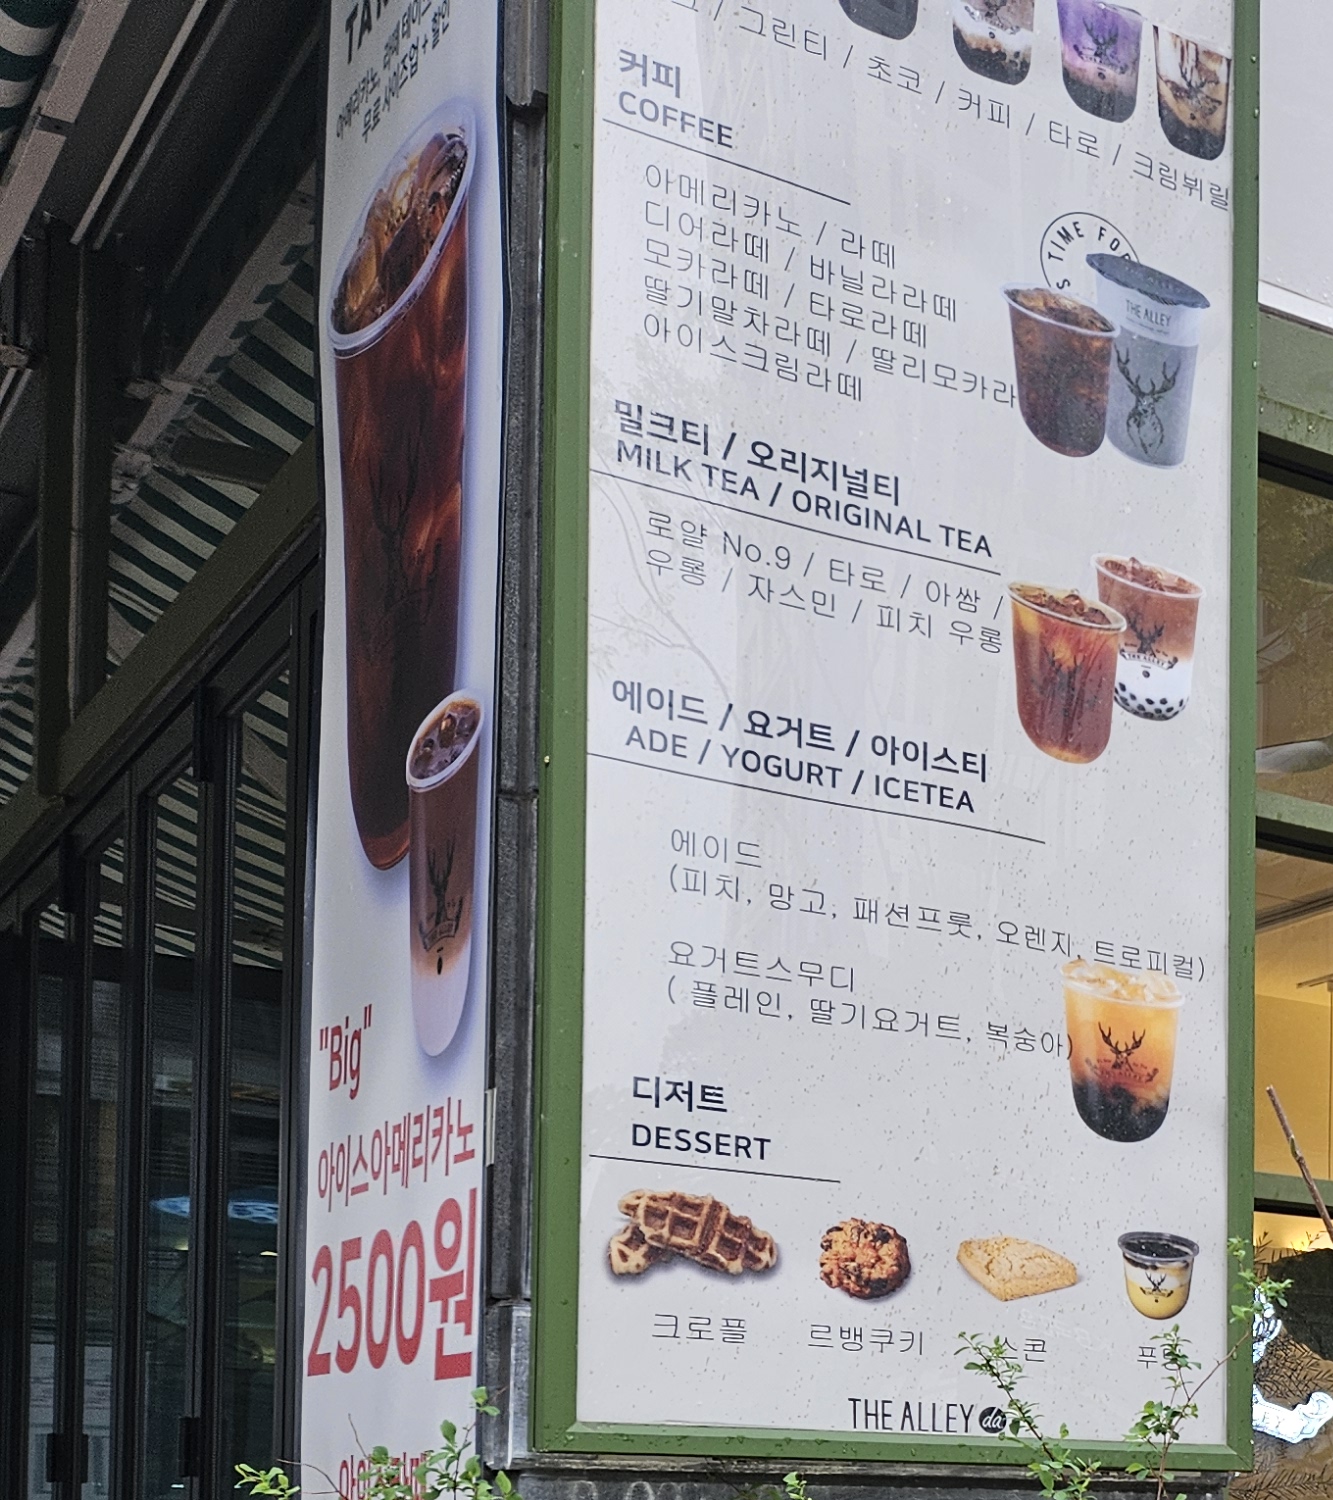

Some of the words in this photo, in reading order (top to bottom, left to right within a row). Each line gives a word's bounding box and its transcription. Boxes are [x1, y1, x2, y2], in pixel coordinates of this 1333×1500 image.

[345, 0, 389, 65] TA
[618, 48, 682, 99] 커피
[362, 96, 381, 143] 무료
[382, 36, 419, 112] 사이즈업
[618, 90, 734, 149] COFFEE
[739, 5, 827, 61] 그린티
[867, 55, 922, 95] 초코
[958, 88, 1010, 129] 커피
[1050, 120, 1100, 158] 타로
[644, 163, 802, 238] 아메리카노
[841, 225, 896, 269] 라떼
[1048, 221, 1084, 262] TIME
[644, 200, 770, 264] 디어라떼
[809, 257, 957, 323] 바닐라라떼
[644, 240, 770, 302] 모카라떼
[810, 291, 928, 349] 타로라떼
[644, 275, 831, 357] 딸기말차라떼
[644, 313, 863, 402] 아이스크림라떼
[1143, 308, 1172, 328] ALLEY
[614, 399, 710, 457] 밀크티
[749, 440, 900, 506] 오리지널티
[615, 440, 691, 484] MILK
[700, 465, 760, 501] TEA
[792, 490, 931, 544] ORIGINAL
[938, 525, 992, 558] TEA
[645, 548, 708, 588] 우롱
[748, 572, 837, 619] 자스민
[876, 603, 934, 640] 피치
[948, 620, 1004, 655] 우롱
[646, 511, 709, 552] 로얄
[723, 534, 791, 571] No.9
[829, 558, 886, 595] 타로
[925, 582, 982, 615] 아쌈
[611, 679, 709, 726] 에이드
[745, 708, 836, 752] 요거트
[870, 734, 988, 782] 아이스티
[625, 724, 687, 760] ADE
[722, 742, 844, 792] YOGURT
[873, 773, 975, 813] ICETEA
[669, 826, 763, 870] 에이드
[668, 862, 752, 907] (피치,
[768, 882, 838, 920] 망고,
[852, 893, 982, 942] 패션프룻,
[995, 920, 1082, 959] 오렌지,
[1092, 938, 1206, 981] 트로피컬)
[667, 941, 856, 993] 요거트스무디
[319, 1003, 372, 1100] "Big"
[691, 980, 794, 1022] 플레인,
[808, 997, 972, 1046] 딸기요거트,
[632, 1075, 728, 1115] 디저트
[318, 1097, 475, 1212] 아이스아메리카노
[631, 1123, 771, 1162] DESSERT
[307, 1187, 477, 1381] 2500원
[652, 1313, 748, 1345] 크로플
[807, 1322, 925, 1357] 르뱅쿠키
[848, 1397, 895, 1432] THE
[900, 1400, 975, 1435] ALLEY
